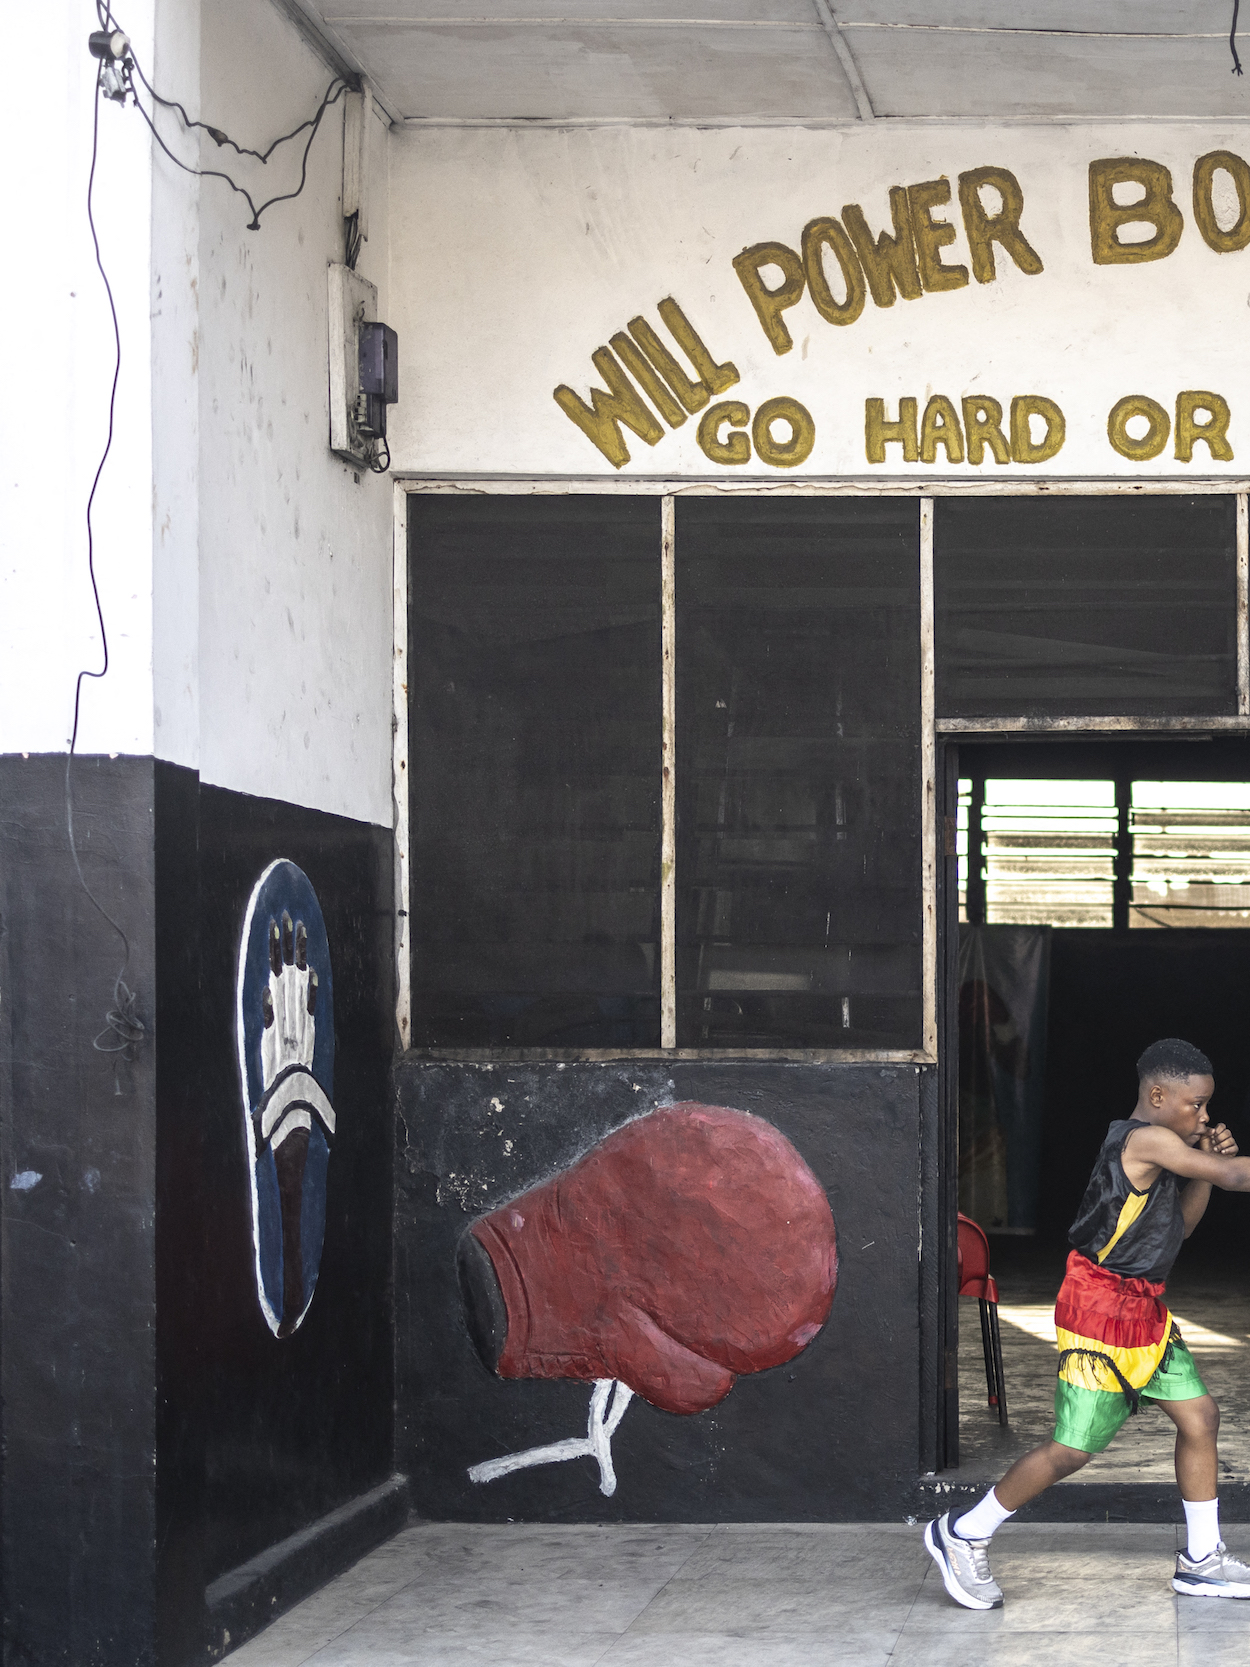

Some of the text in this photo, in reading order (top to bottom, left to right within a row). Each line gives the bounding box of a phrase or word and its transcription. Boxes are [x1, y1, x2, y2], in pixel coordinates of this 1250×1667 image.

[553, 299, 741, 470] WILL
[731, 165, 1045, 358] POWER
[695, 395, 816, 469] GO
[864, 394, 1067, 466] HARD
[1107, 389, 1234, 465] OR
